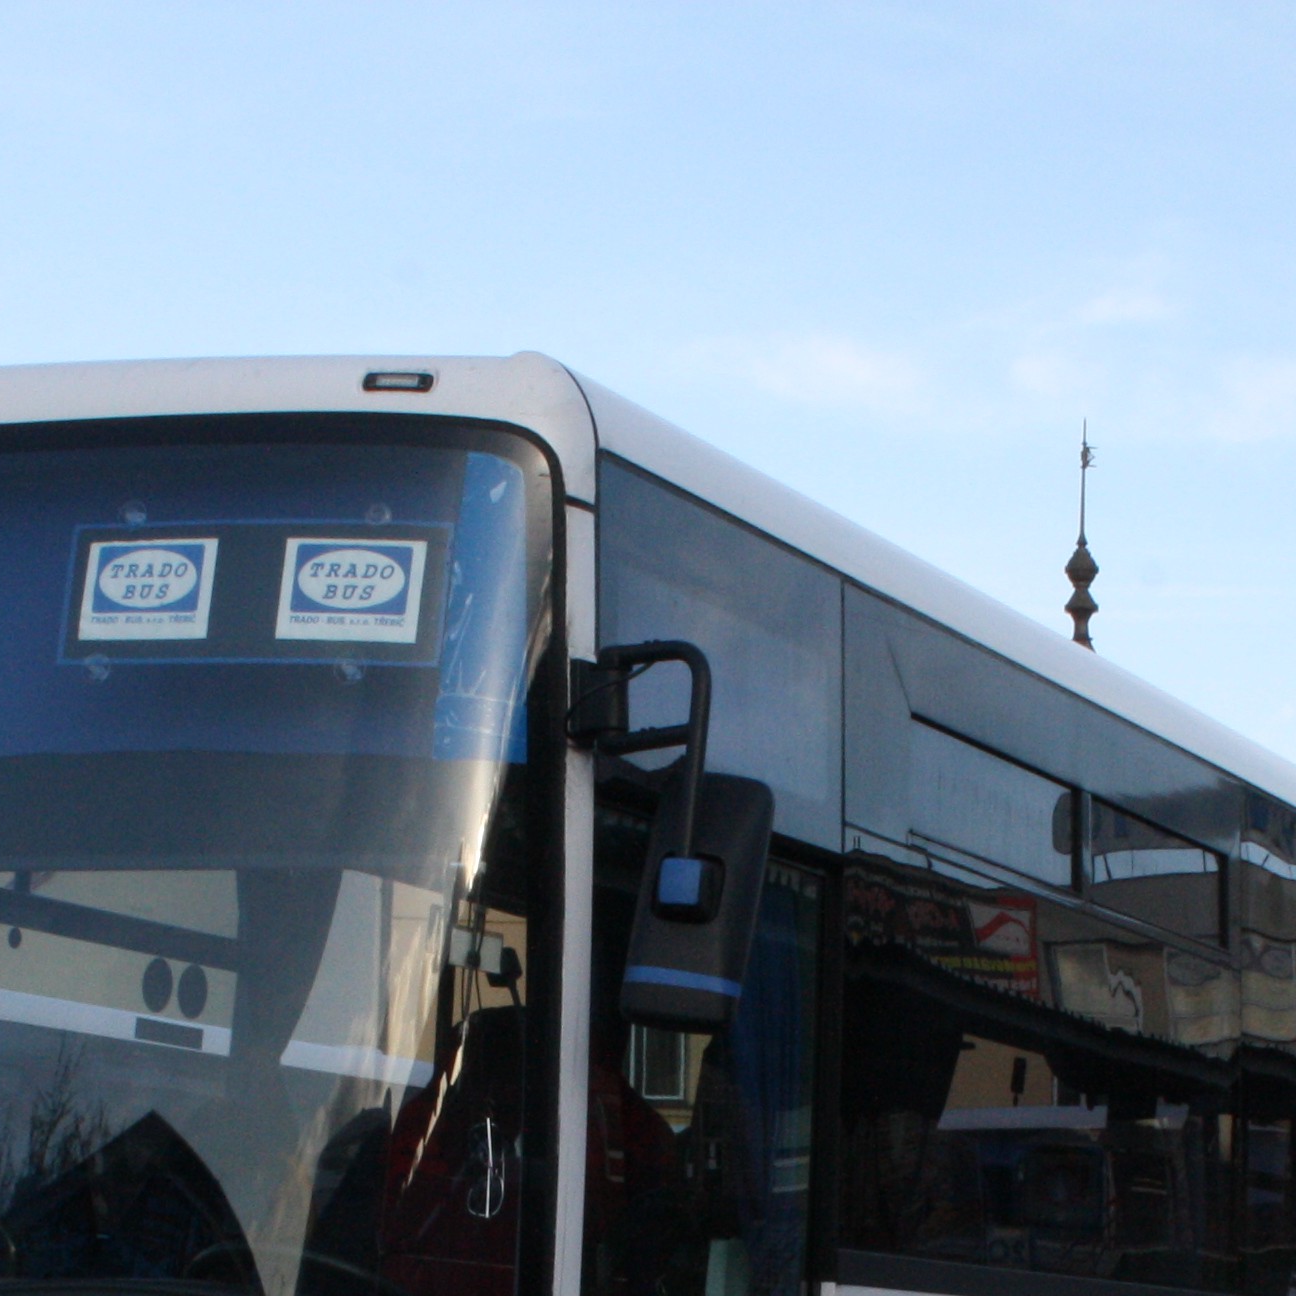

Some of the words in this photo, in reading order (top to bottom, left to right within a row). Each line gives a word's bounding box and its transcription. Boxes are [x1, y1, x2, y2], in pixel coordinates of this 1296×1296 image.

[110, 562, 189, 579] TRADO
[309, 562, 394, 579] TRADO
[122, 583, 170, 600] BUS
[322, 583, 375, 600] BUS
